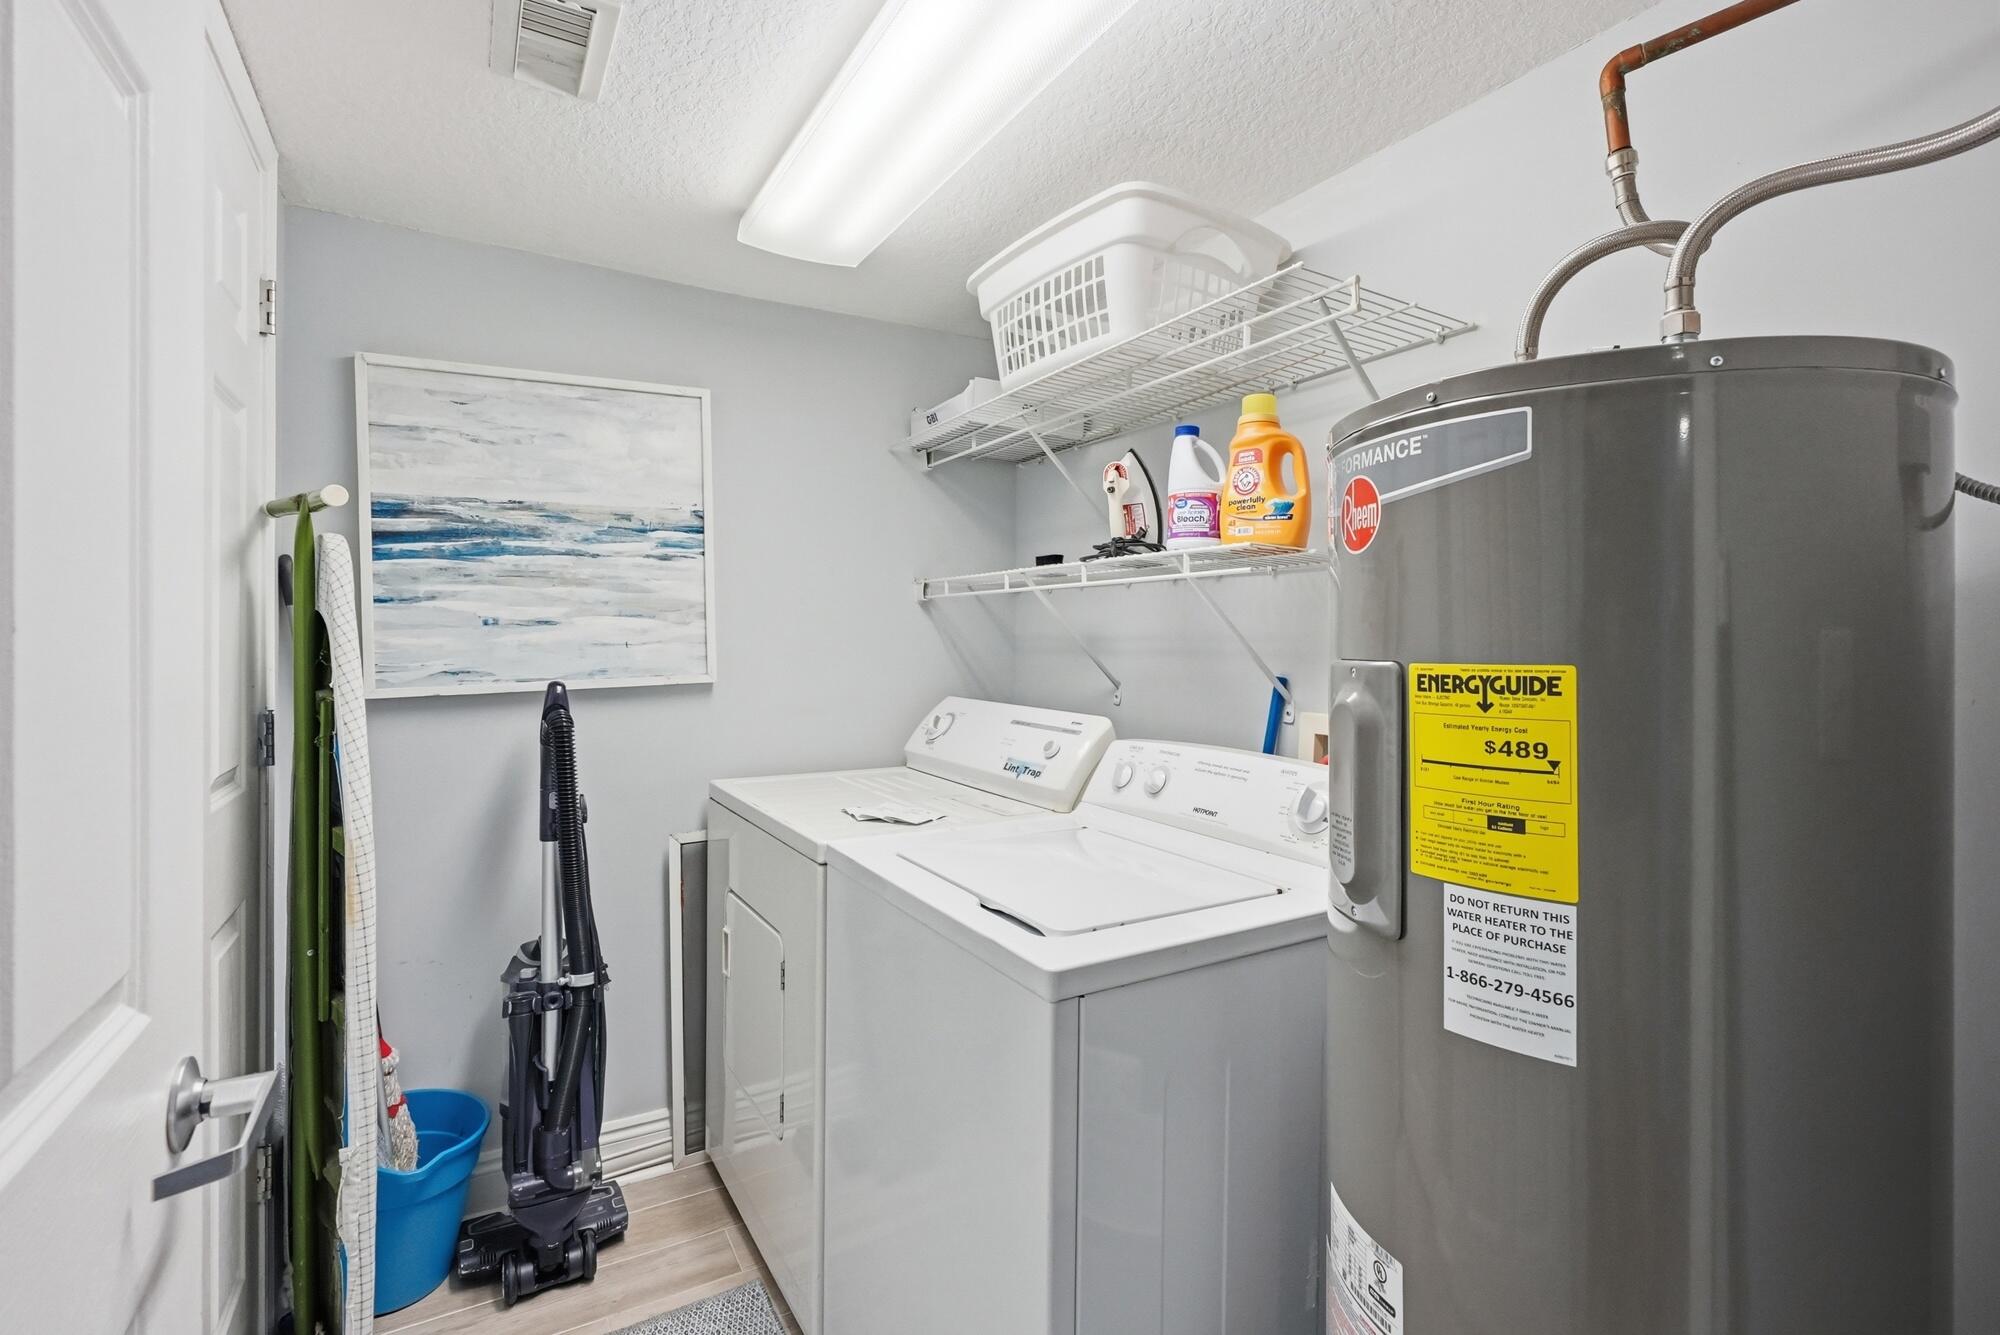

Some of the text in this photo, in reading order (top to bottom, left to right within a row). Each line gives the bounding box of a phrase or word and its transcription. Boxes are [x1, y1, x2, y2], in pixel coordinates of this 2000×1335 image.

[1228, 496, 1266, 506] powerfully
[1344, 480, 1376, 542] Rheem
[1417, 674, 1562, 696] ENERGYGUIDE
[1491, 726, 1512, 734] Energy
[1485, 740, 1548, 759] $489
[1003, 762, 1042, 778] Lint Trap
[1497, 802, 1520, 811] Rating
[1450, 893, 1570, 924] DO NOT RETURN THIS
[1447, 907, 1574, 940] WATER HEATER TO THE
[1452, 922, 1482, 937] PLACE
[1486, 931, 1502, 941] OF
[1504, 934, 1567, 954] PURCHASE
[1447, 966, 1574, 1008] 1-866-279-4566
